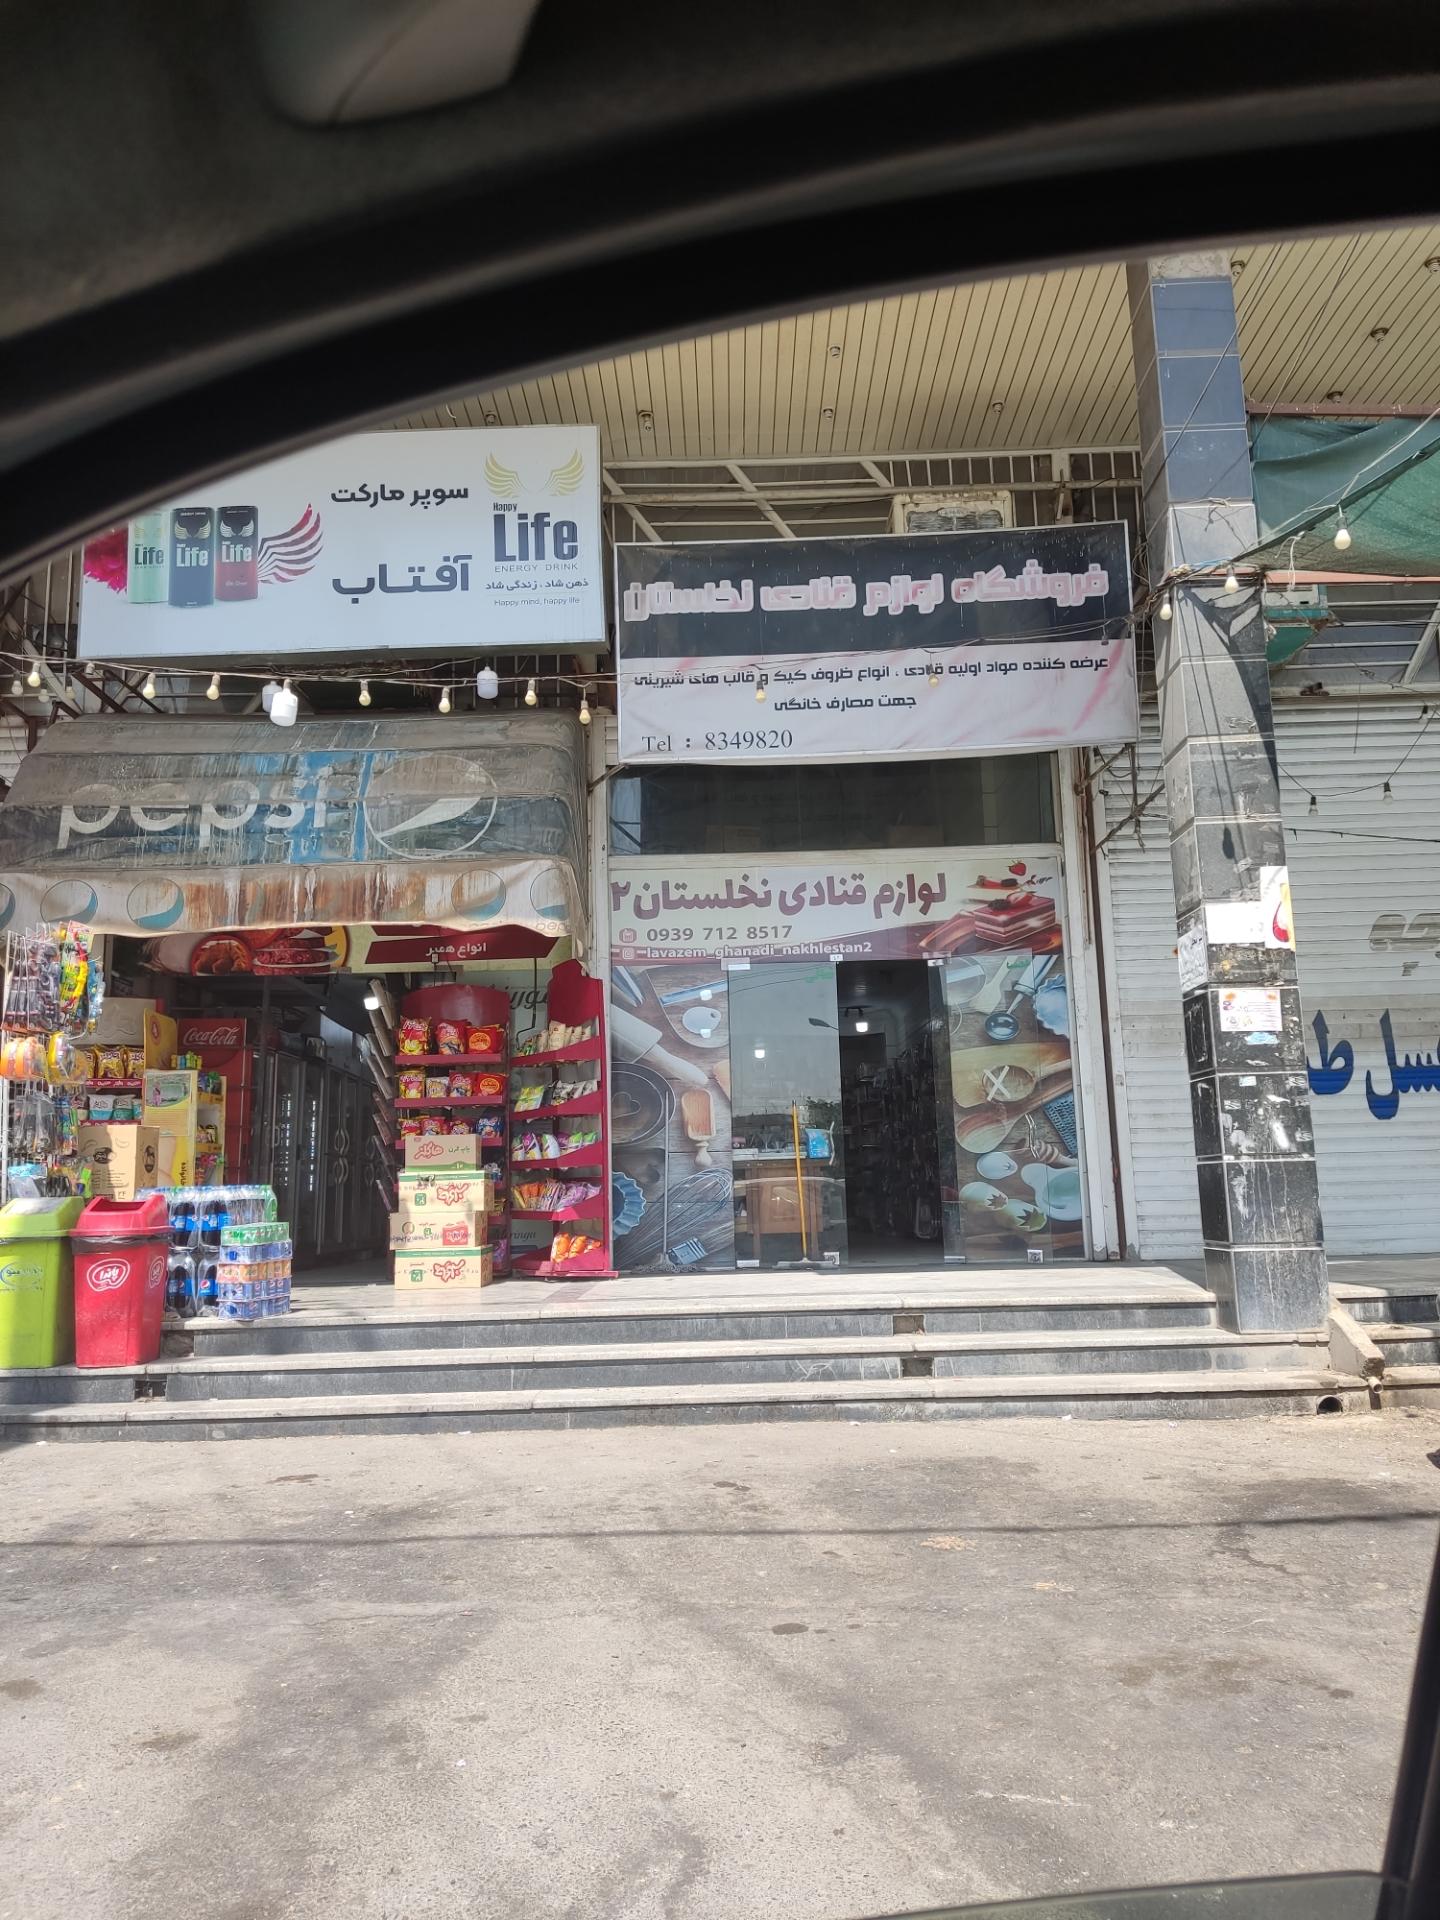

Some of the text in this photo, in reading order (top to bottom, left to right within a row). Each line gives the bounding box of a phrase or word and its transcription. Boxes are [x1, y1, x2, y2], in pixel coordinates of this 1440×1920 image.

[330, 483, 469, 510] سوپر مارکت
[493, 502, 518, 512] Happy
[493, 512, 579, 562] Life
[134, 546, 165, 565] Life
[176, 546, 209, 567] Life
[221, 543, 252, 562] Life
[494, 563, 579, 573] ENERGY DRINK
[332, 554, 473, 604] آفتاب
[485, 578, 589, 591] ذهن شاد زندگی شاد
[951, 559, 1110, 607] فروشگاه
[863, 573, 945, 616] لوازم
[948, 662, 982, 677] اولیه
[986, 661, 1018, 675] مواد
[1022, 657, 1066, 671] کننده
[1070, 657, 1109, 672] عرضه
[634, 670, 685, 689] شیرینی
[723, 671, 755, 687] قالب
[773, 669, 807, 684] کیک
[811, 667, 853, 683] ظروف
[857, 666, 890, 682] انواع
[774, 694, 917, 712] جهت مصارف خانگی
[641, 735, 672, 752] Tel
[705, 729, 793, 751] 8349820
[779, 872, 867, 916] قنادی
[873, 872, 947, 920] لوازم
[646, 925, 793, 942] 0939 712 8517
[456, 942, 487, 958] انواع
[183, 1025, 241, 1046] Coca-Cola
